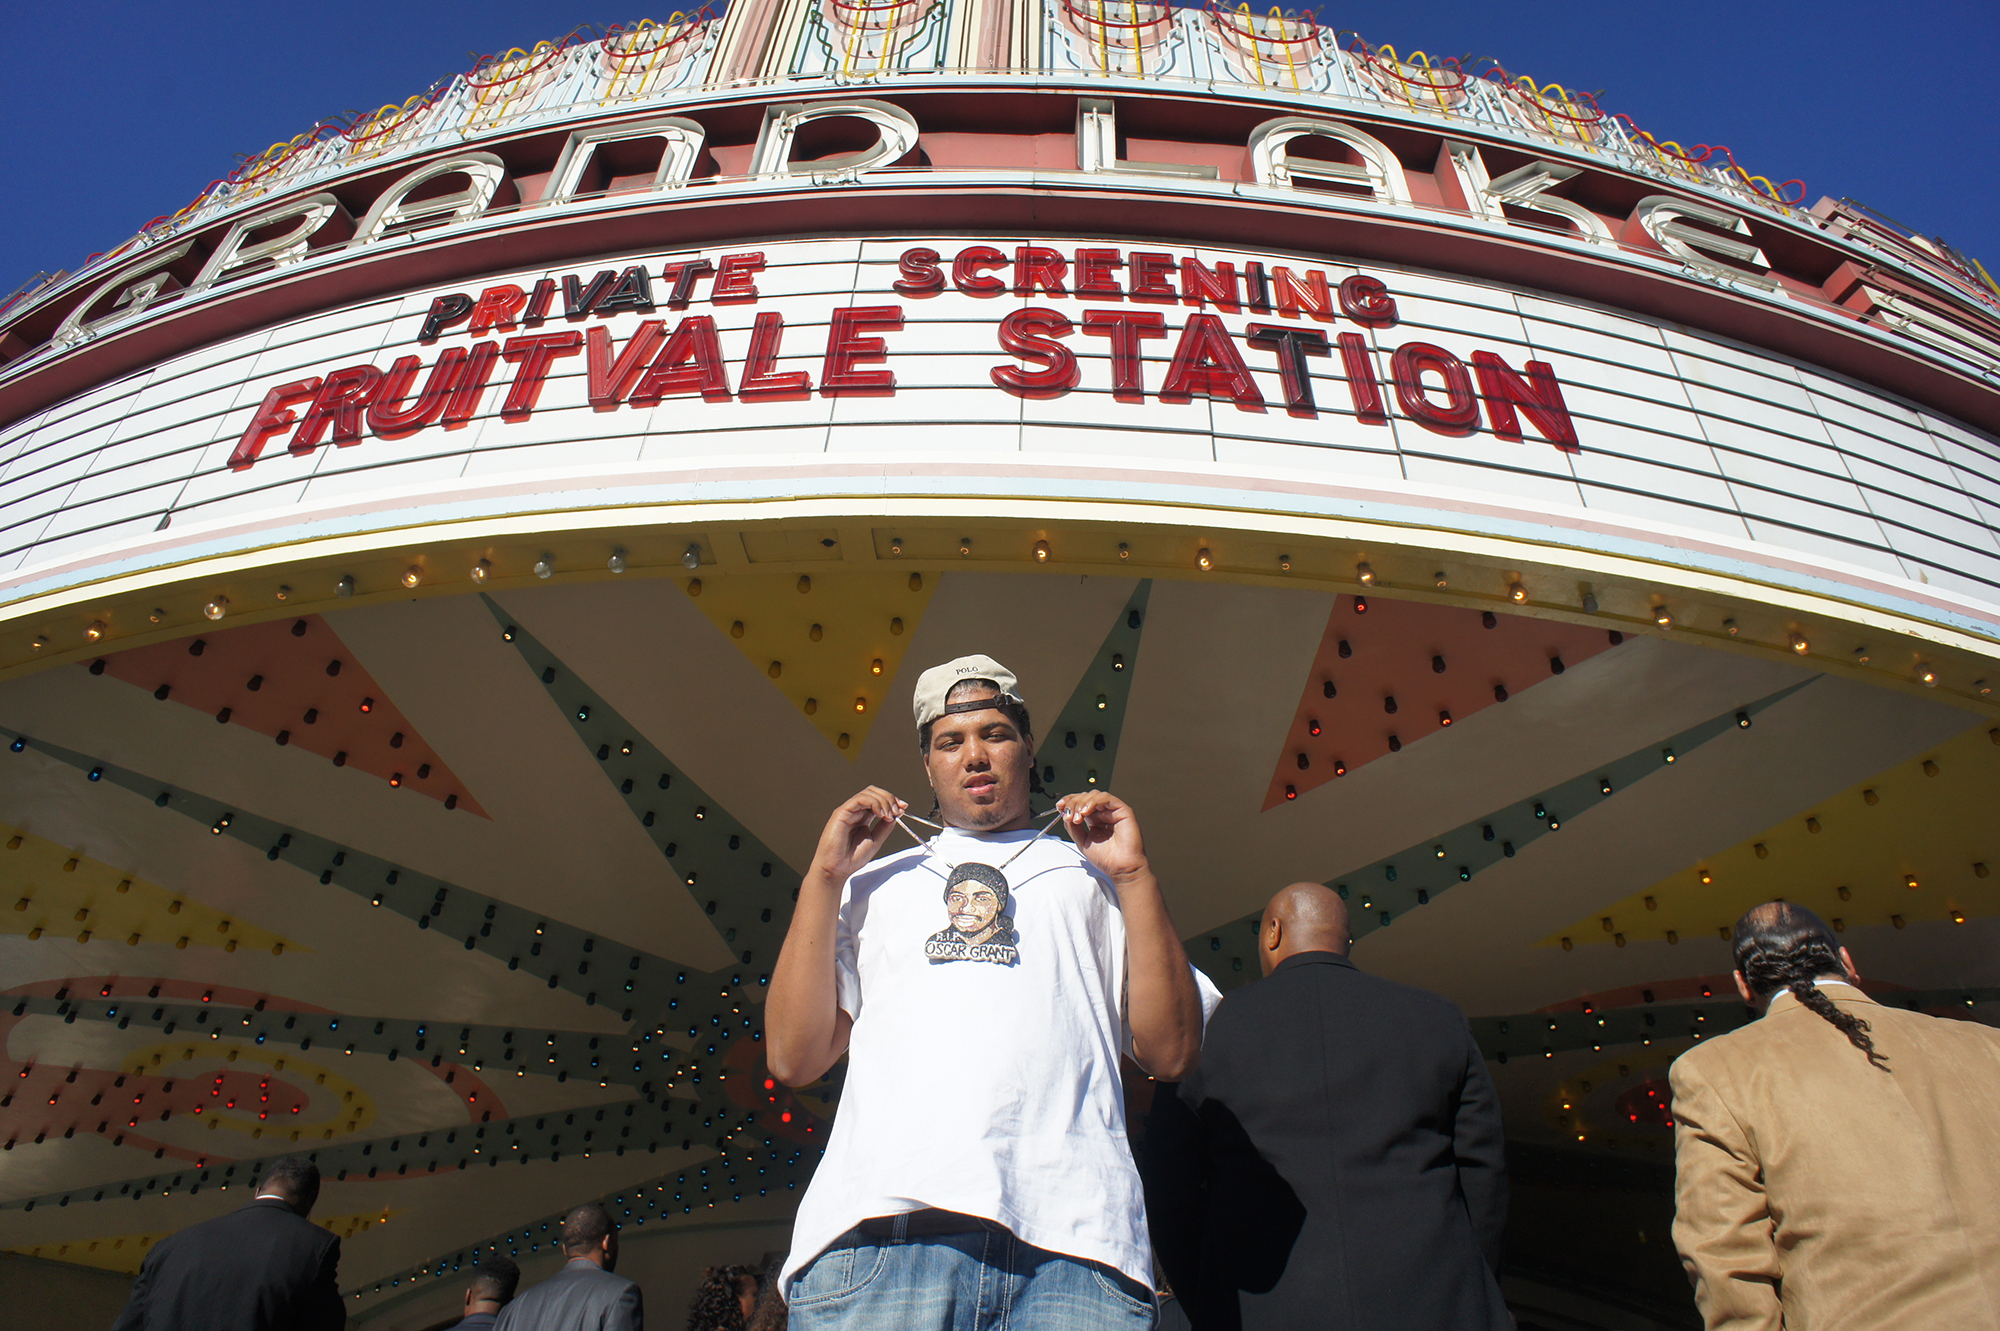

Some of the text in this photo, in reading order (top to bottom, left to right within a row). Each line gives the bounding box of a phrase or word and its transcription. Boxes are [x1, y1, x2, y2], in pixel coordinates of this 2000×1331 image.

[50, 97, 1790, 349] GRAND LAKE
[417, 246, 1398, 343] PRIVATE SCREENING
[227, 304, 1581, 470] FRUITVALE STATION
[955, 666, 979, 675] POLO
[925, 942, 1014, 962] OSCAR GRANT
